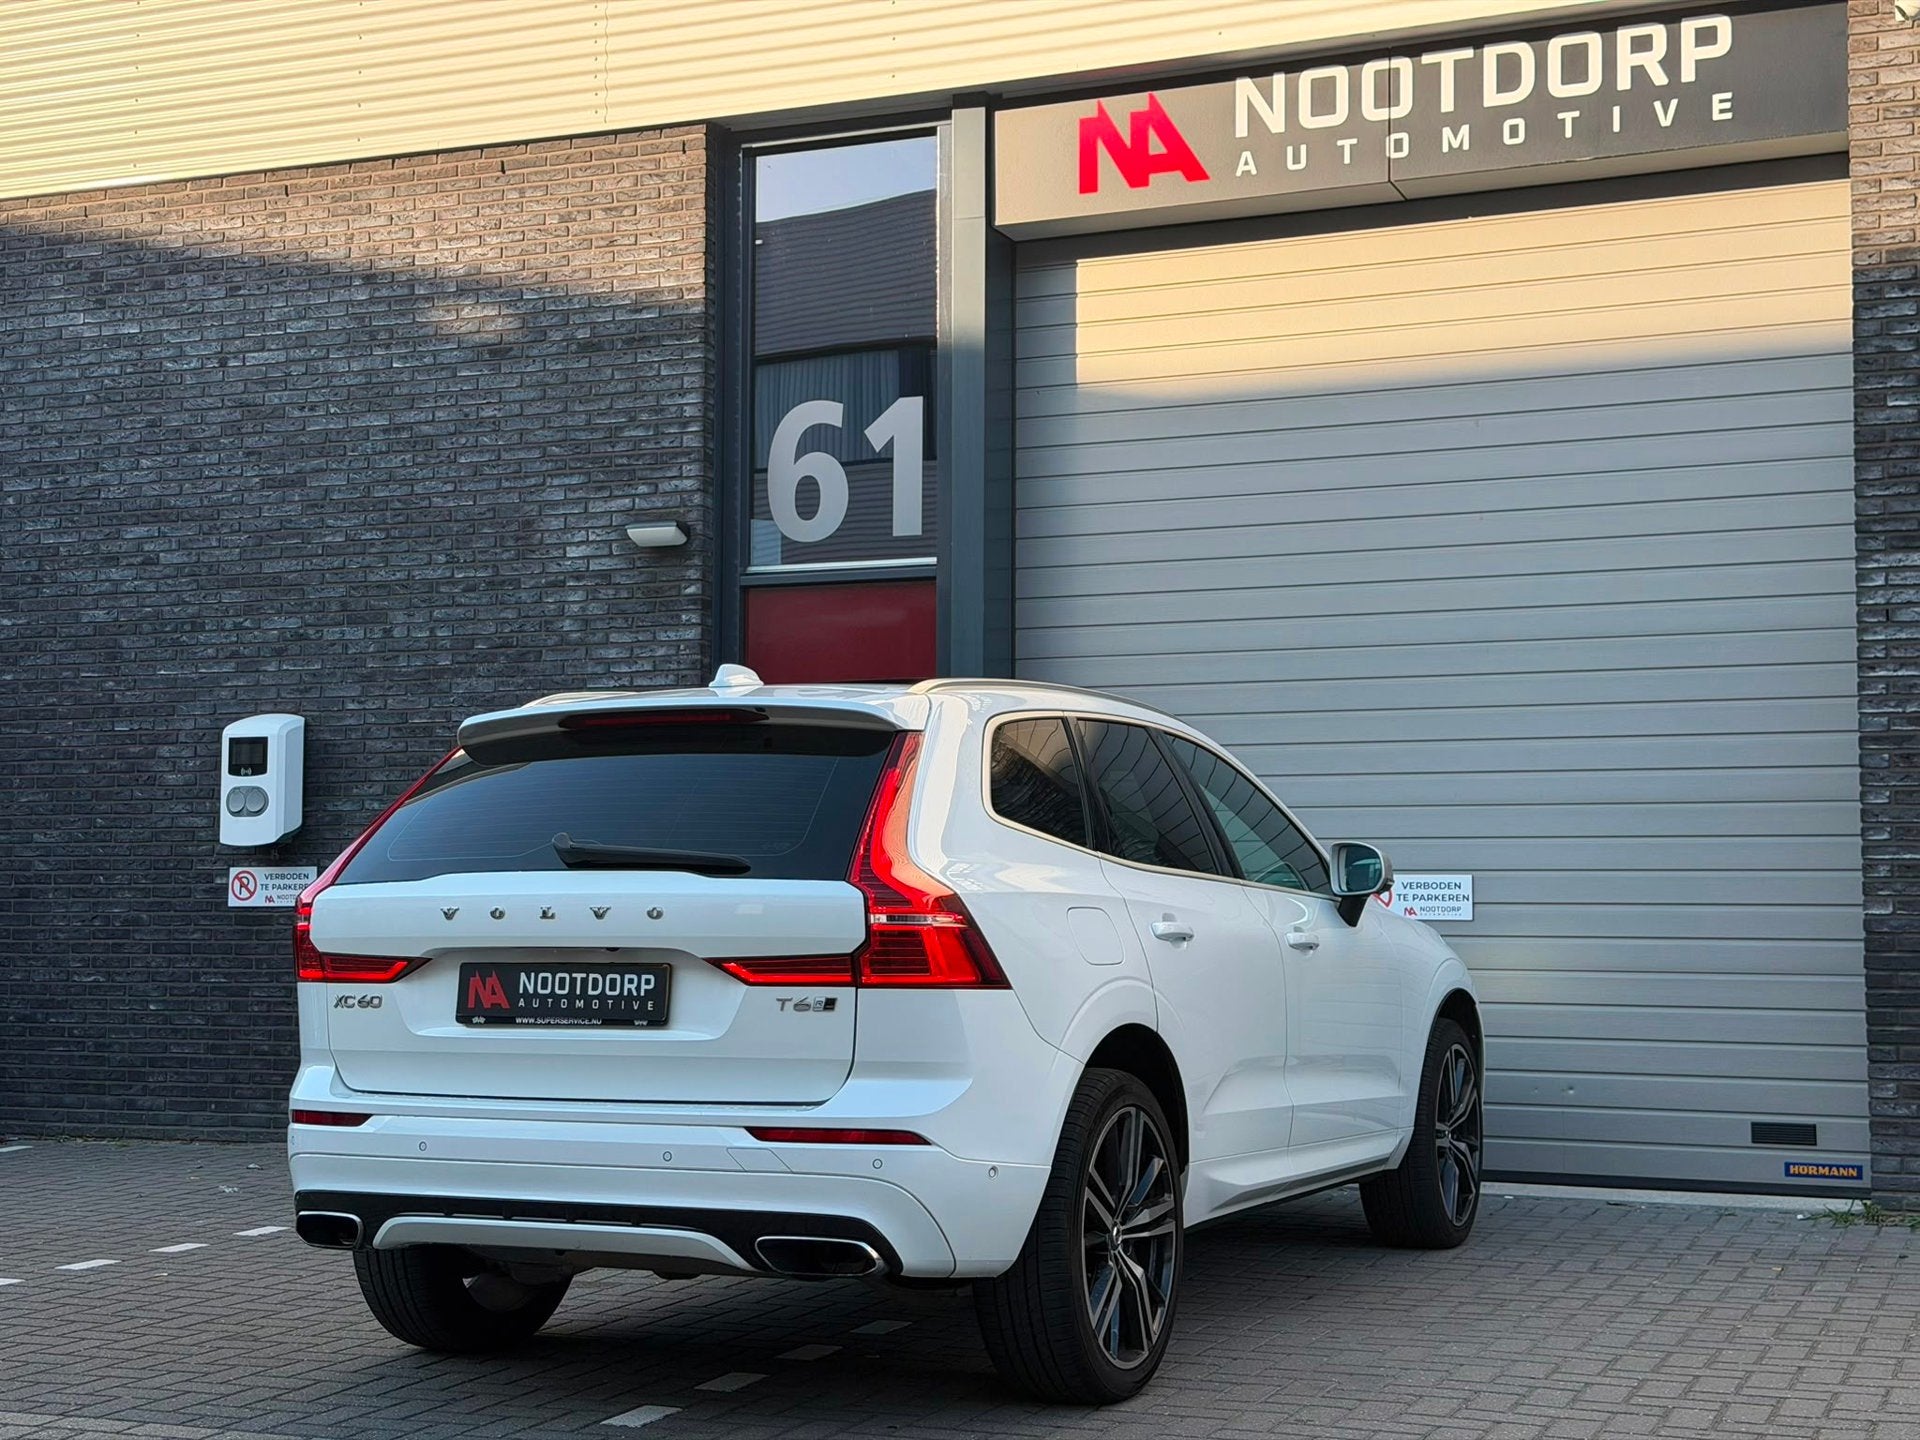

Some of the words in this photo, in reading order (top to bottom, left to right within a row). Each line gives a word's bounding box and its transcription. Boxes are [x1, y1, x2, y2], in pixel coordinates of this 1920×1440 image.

[1232, 13, 1735, 139] NOOTDORP
[1234, 91, 1735, 178] AUTOMOTIVE
[767, 396, 924, 543] 61
[260, 883, 268, 891] TE
[1401, 881, 1462, 890] VERBODEN
[1396, 893, 1409, 902] TE
[1413, 893, 1470, 902] PARKEREN
[440, 905, 664, 921] VOLVO
[518, 971, 656, 997] NOOTDORP
[333, 993, 383, 1009] XC60
[518, 998, 655, 1011] AUTOMOTIVE
[776, 996, 811, 1013] T6
